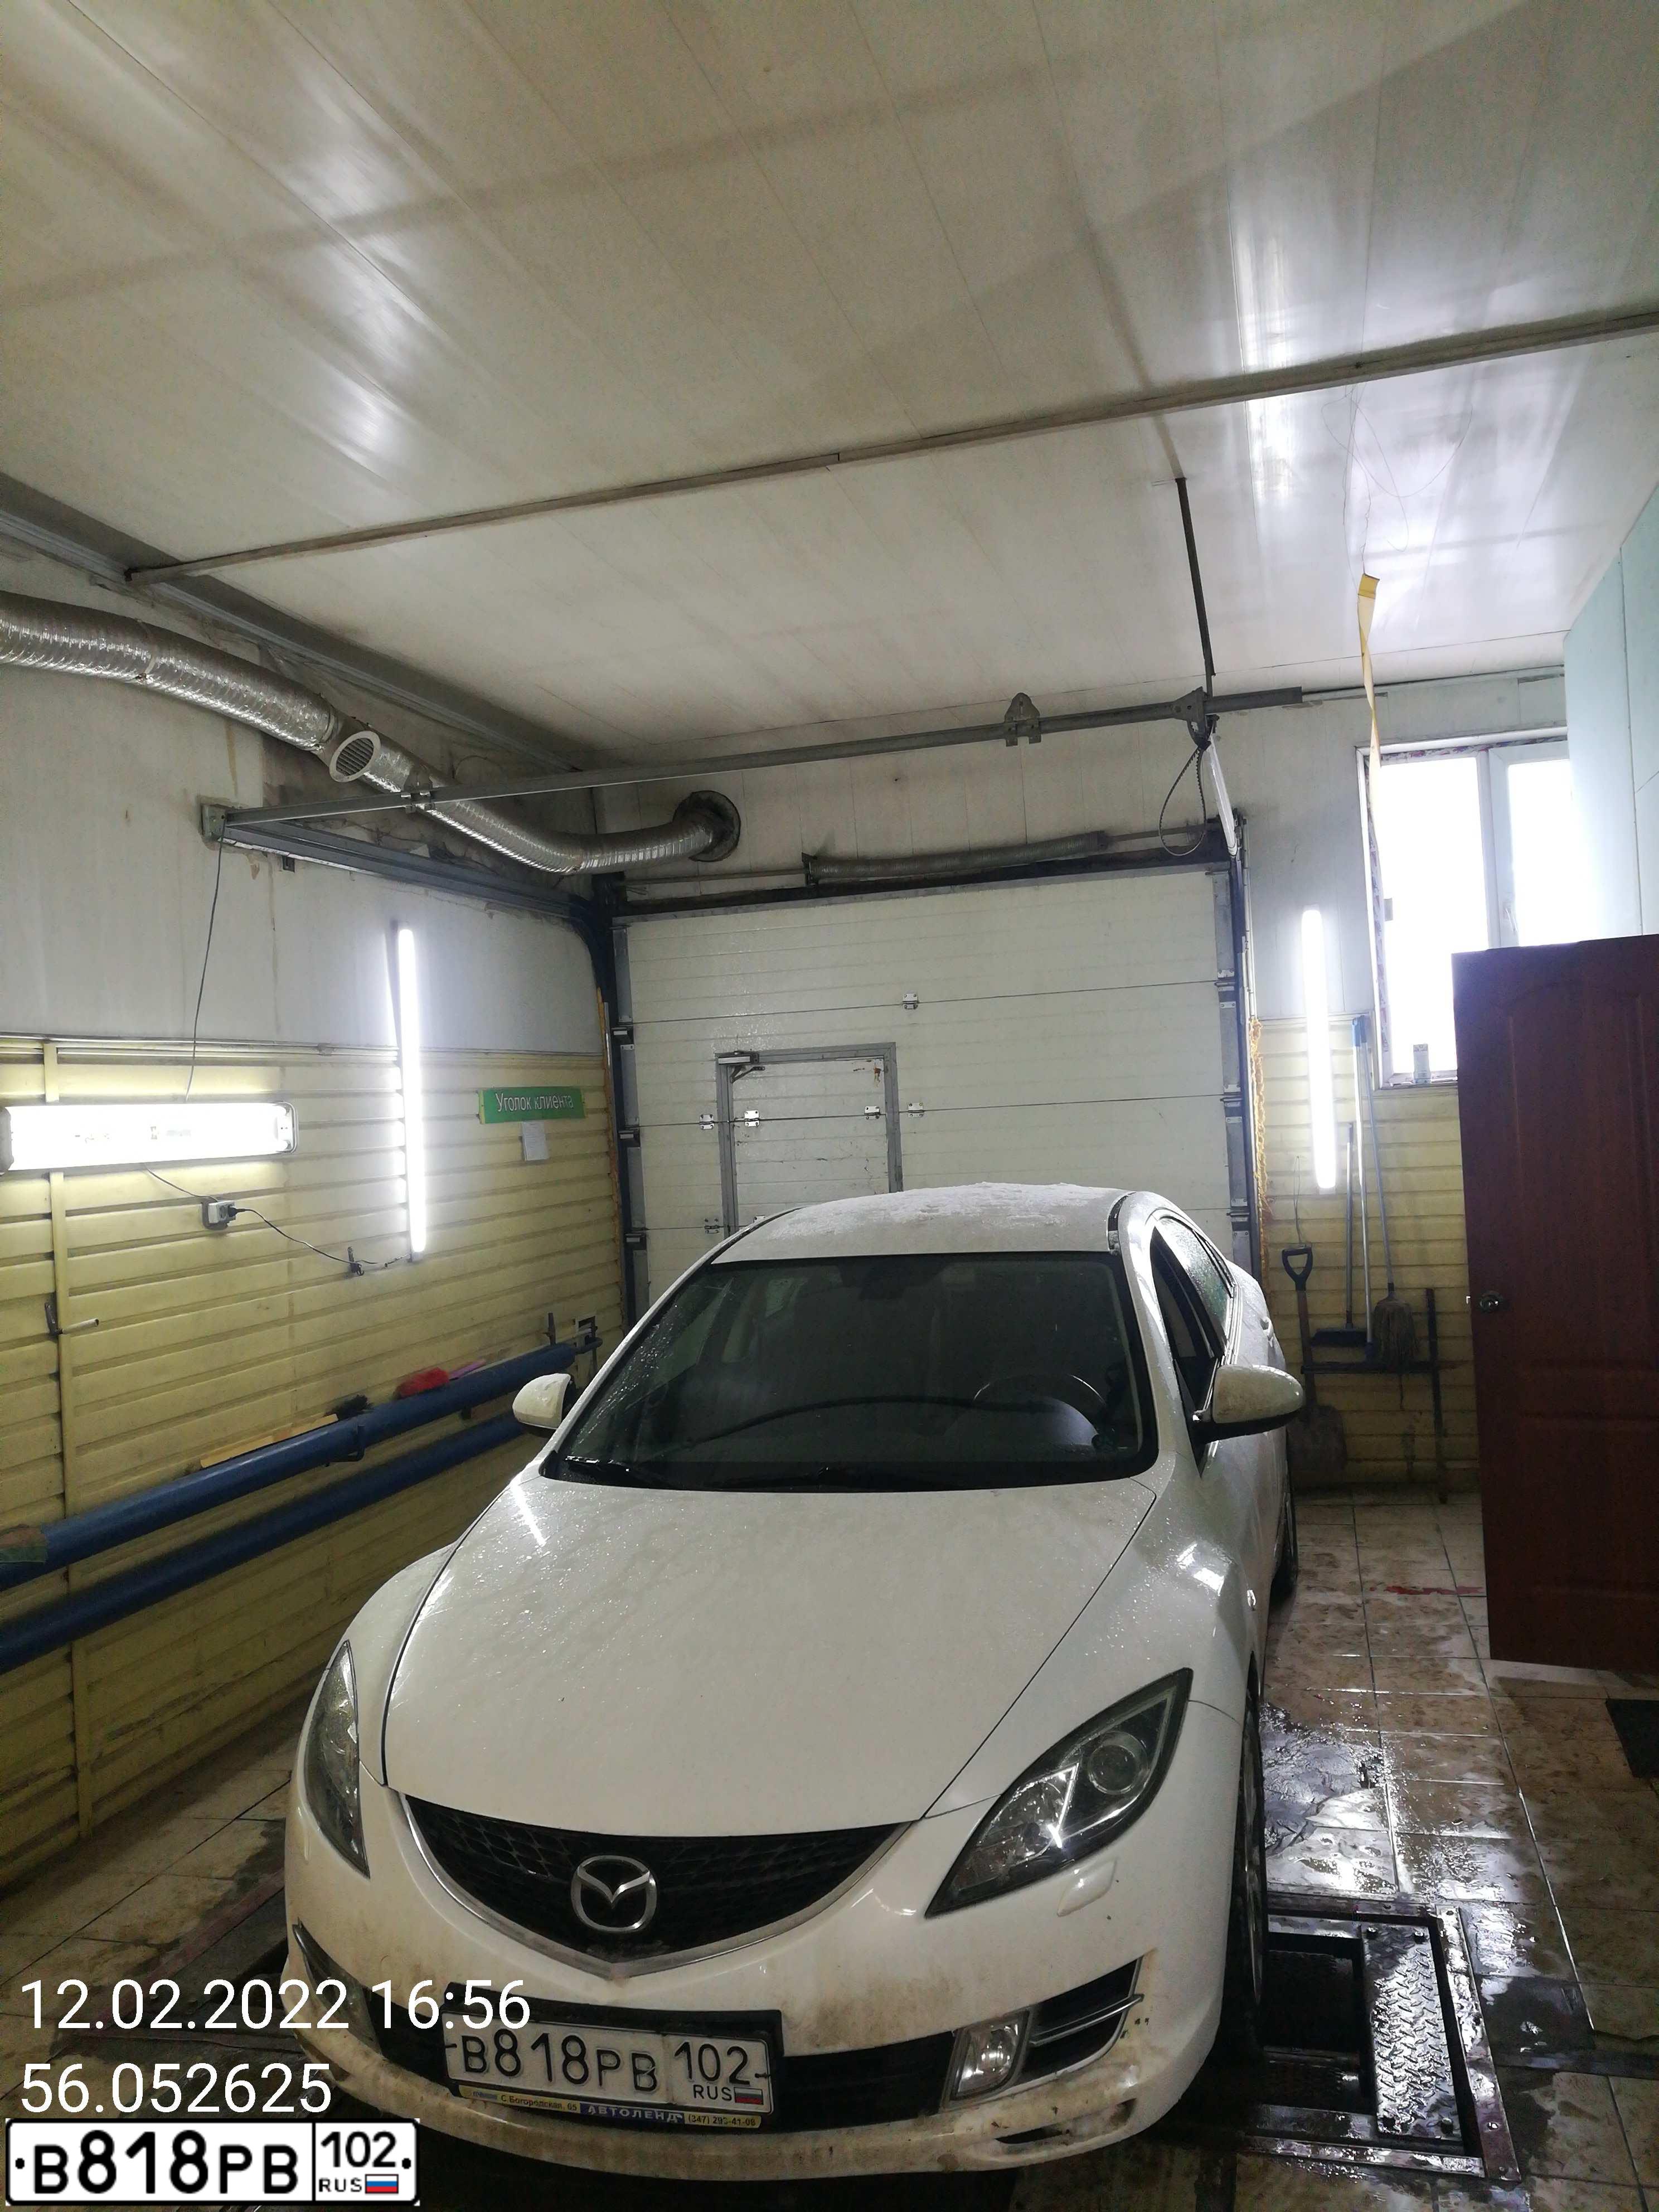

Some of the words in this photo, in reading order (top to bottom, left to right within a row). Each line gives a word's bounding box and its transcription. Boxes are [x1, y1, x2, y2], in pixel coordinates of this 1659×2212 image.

[495, 1093, 532, 1112] Уголок
[535, 1094, 574, 1110] клиента
[462, 2028, 658, 2093] В818РВ
[674, 2041, 751, 2086] 102
[693, 2084, 734, 2102] RUS
[588, 2104, 683, 2123] АВТОЛЕНД
[688, 2114, 710, 2125] (347)
